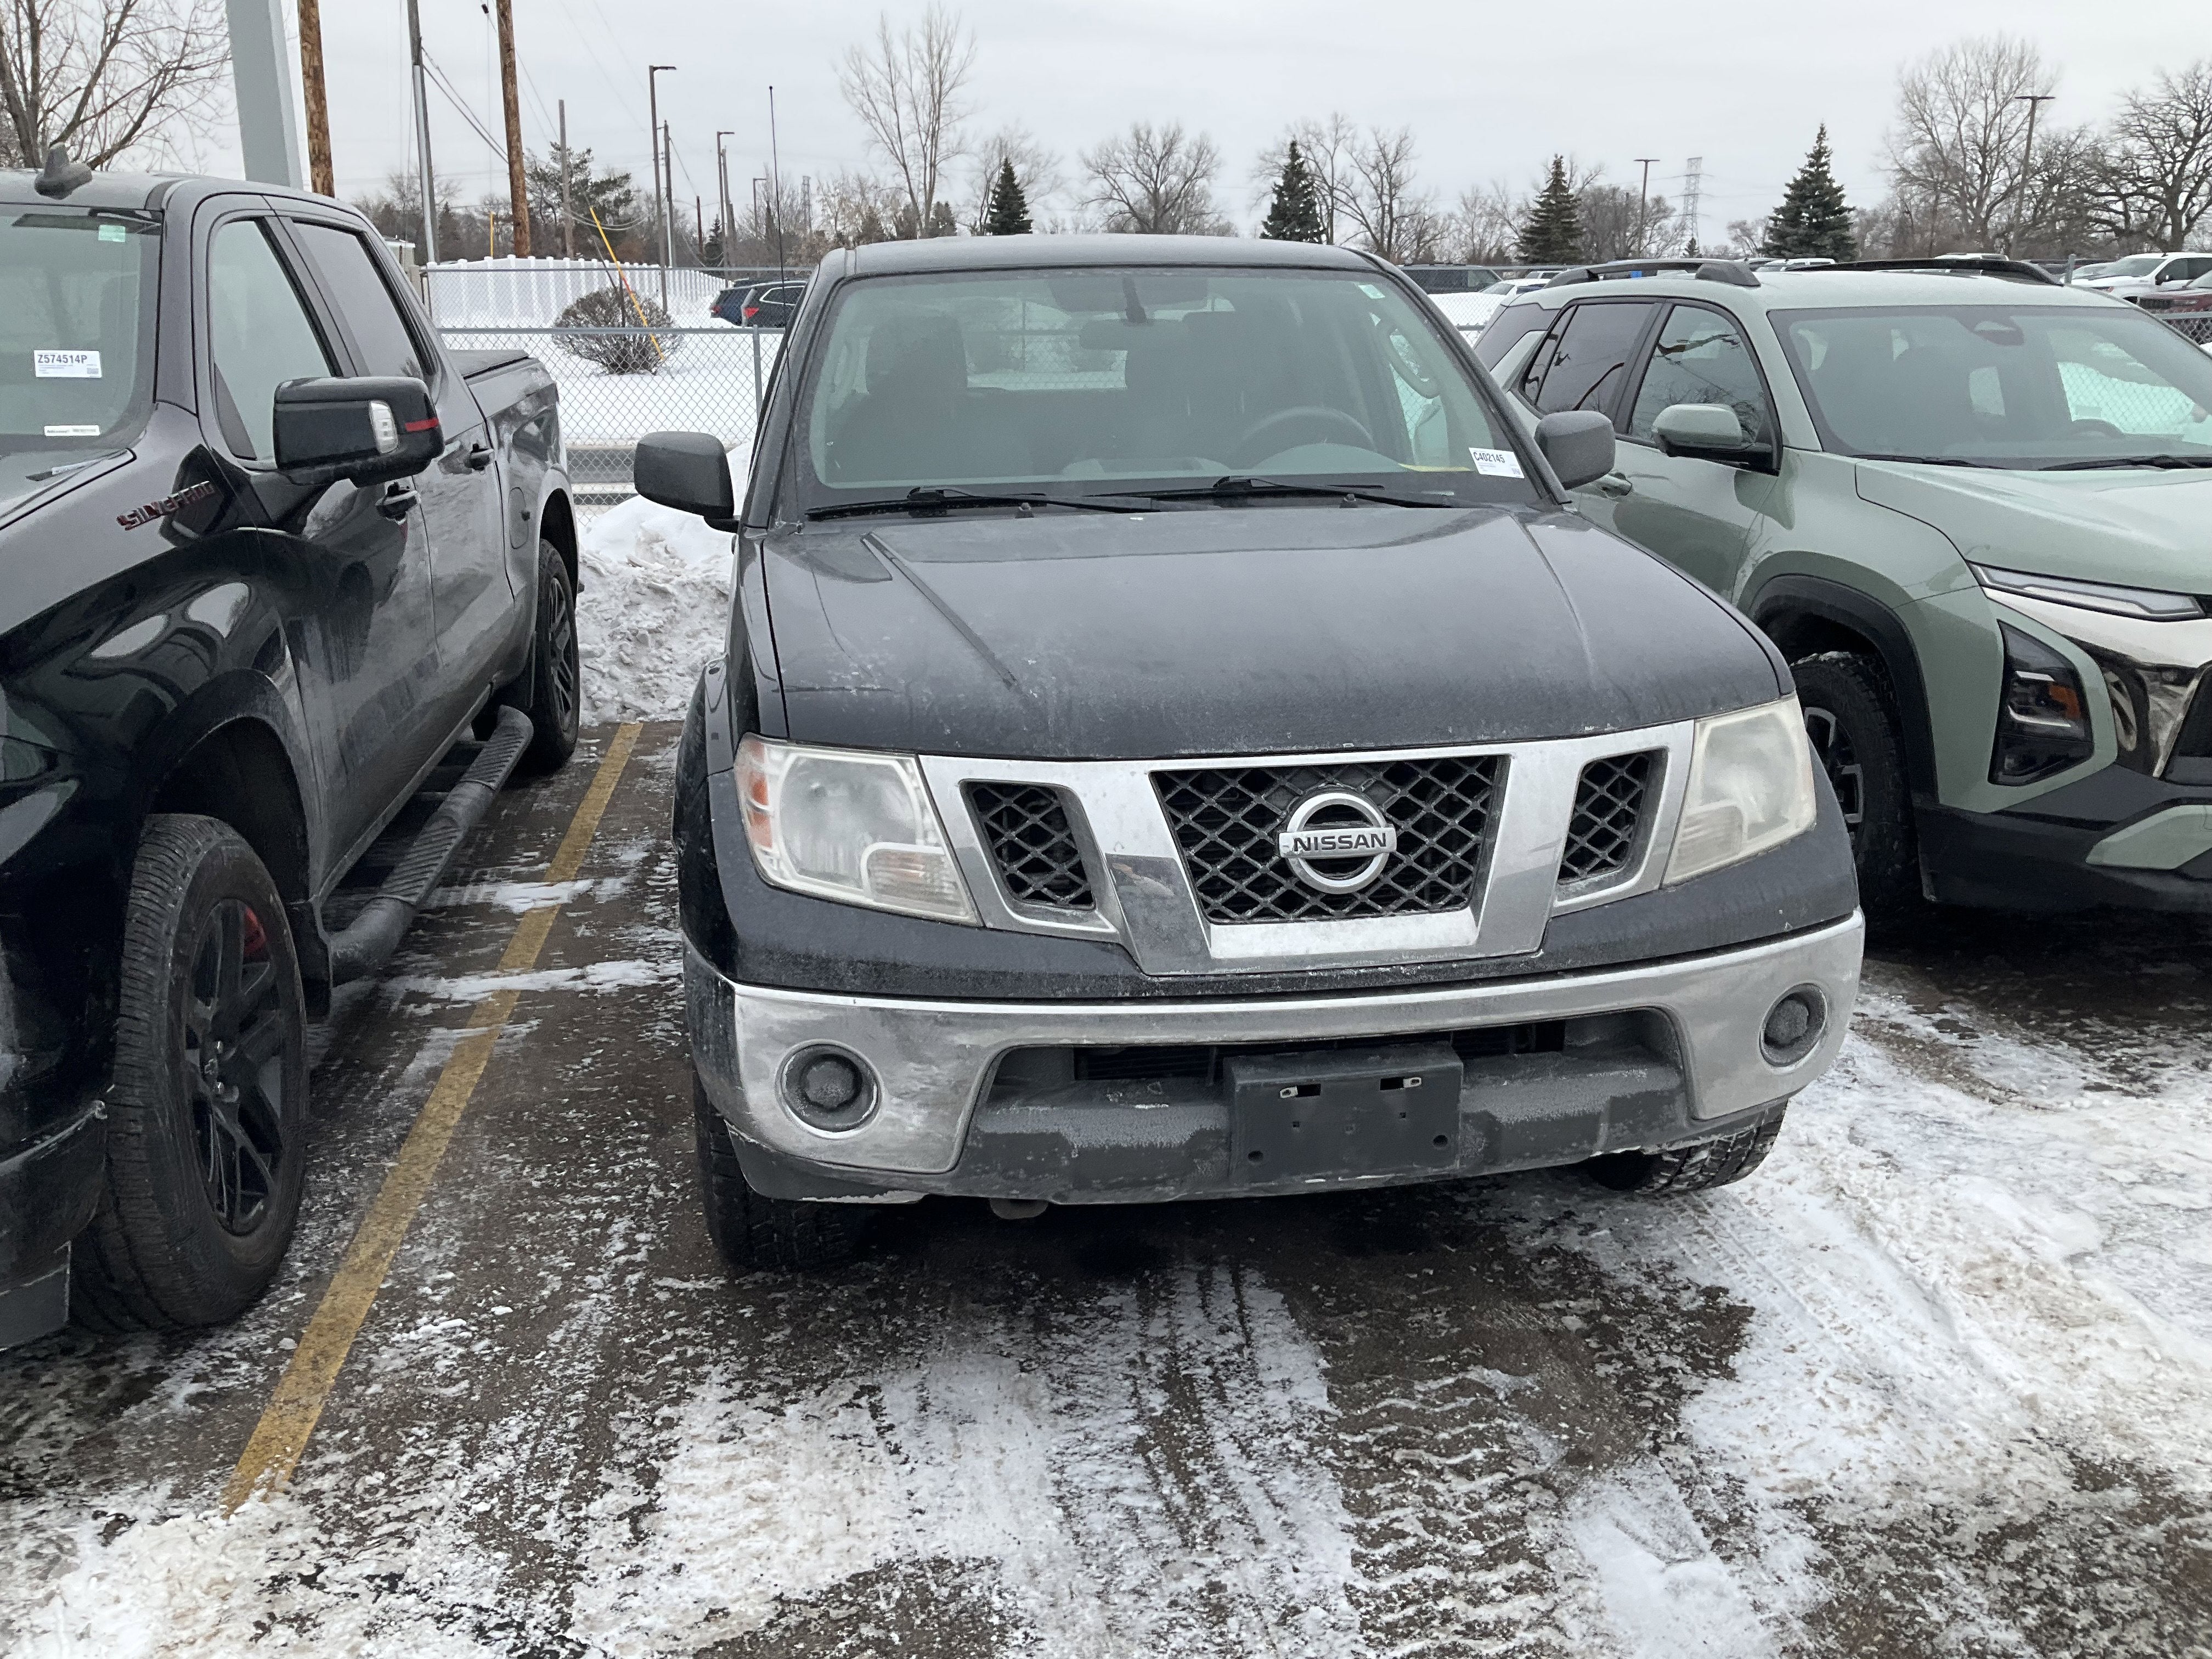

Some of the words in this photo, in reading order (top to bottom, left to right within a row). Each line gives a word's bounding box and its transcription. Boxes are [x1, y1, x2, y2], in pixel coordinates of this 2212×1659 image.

[37, 354, 88, 364] Z574514P
[1473, 452, 1505, 463] C402145
[1293, 833, 1387, 853] NISSAN
